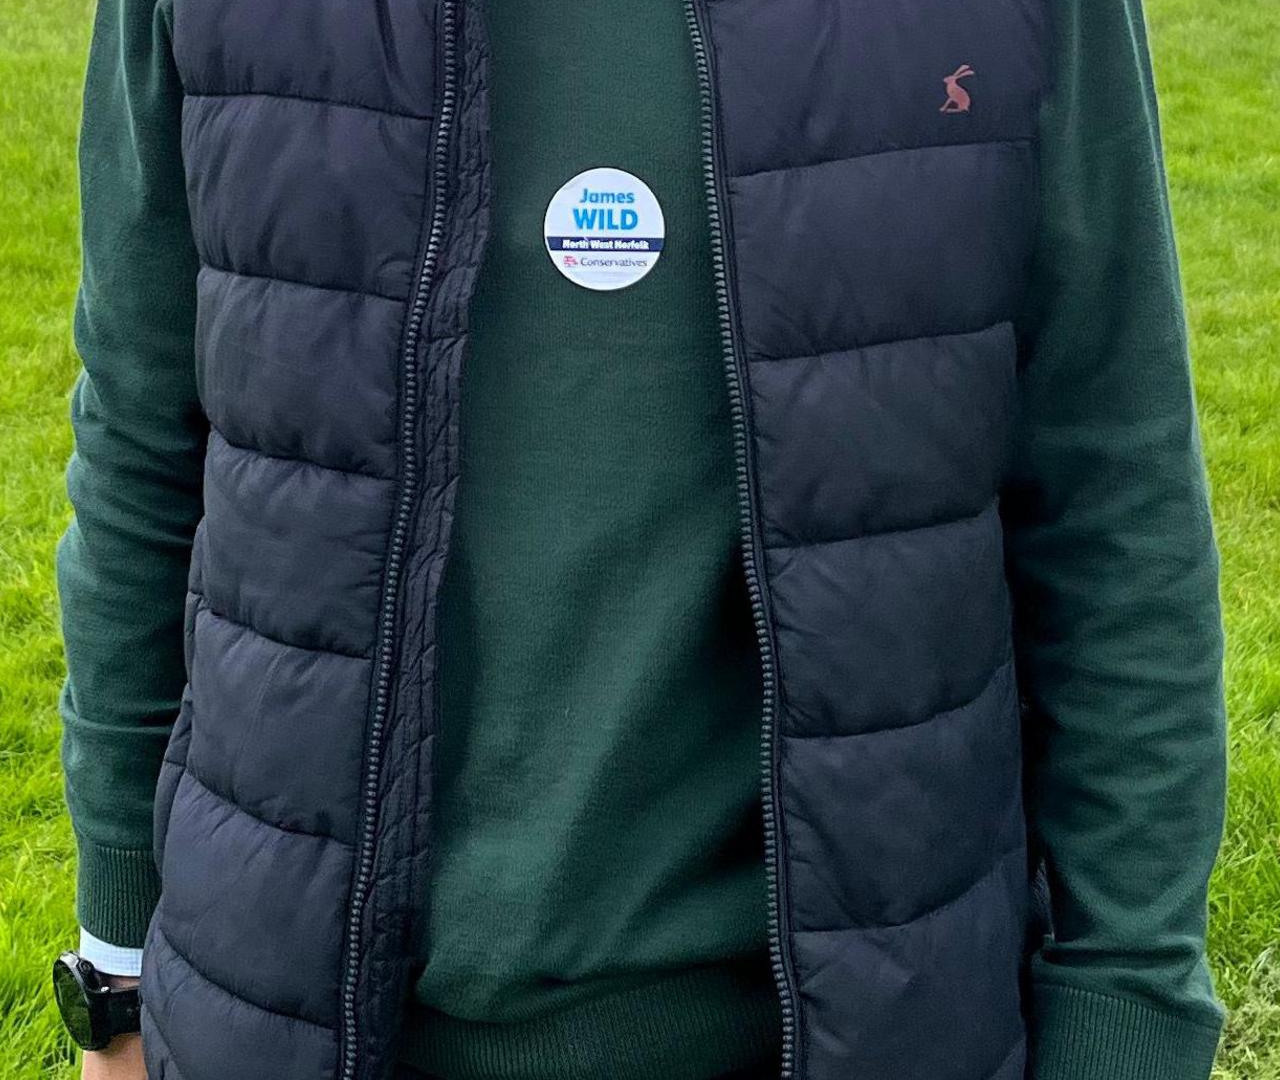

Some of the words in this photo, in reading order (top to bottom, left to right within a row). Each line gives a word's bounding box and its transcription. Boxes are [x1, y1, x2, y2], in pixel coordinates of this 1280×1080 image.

[579, 188, 634, 203] James
[573, 208, 638, 230] WILD
[562, 239, 589, 249] North
[590, 240, 613, 249] West
[614, 240, 650, 250] Norfolk
[580, 257, 648, 267] Conservatives
